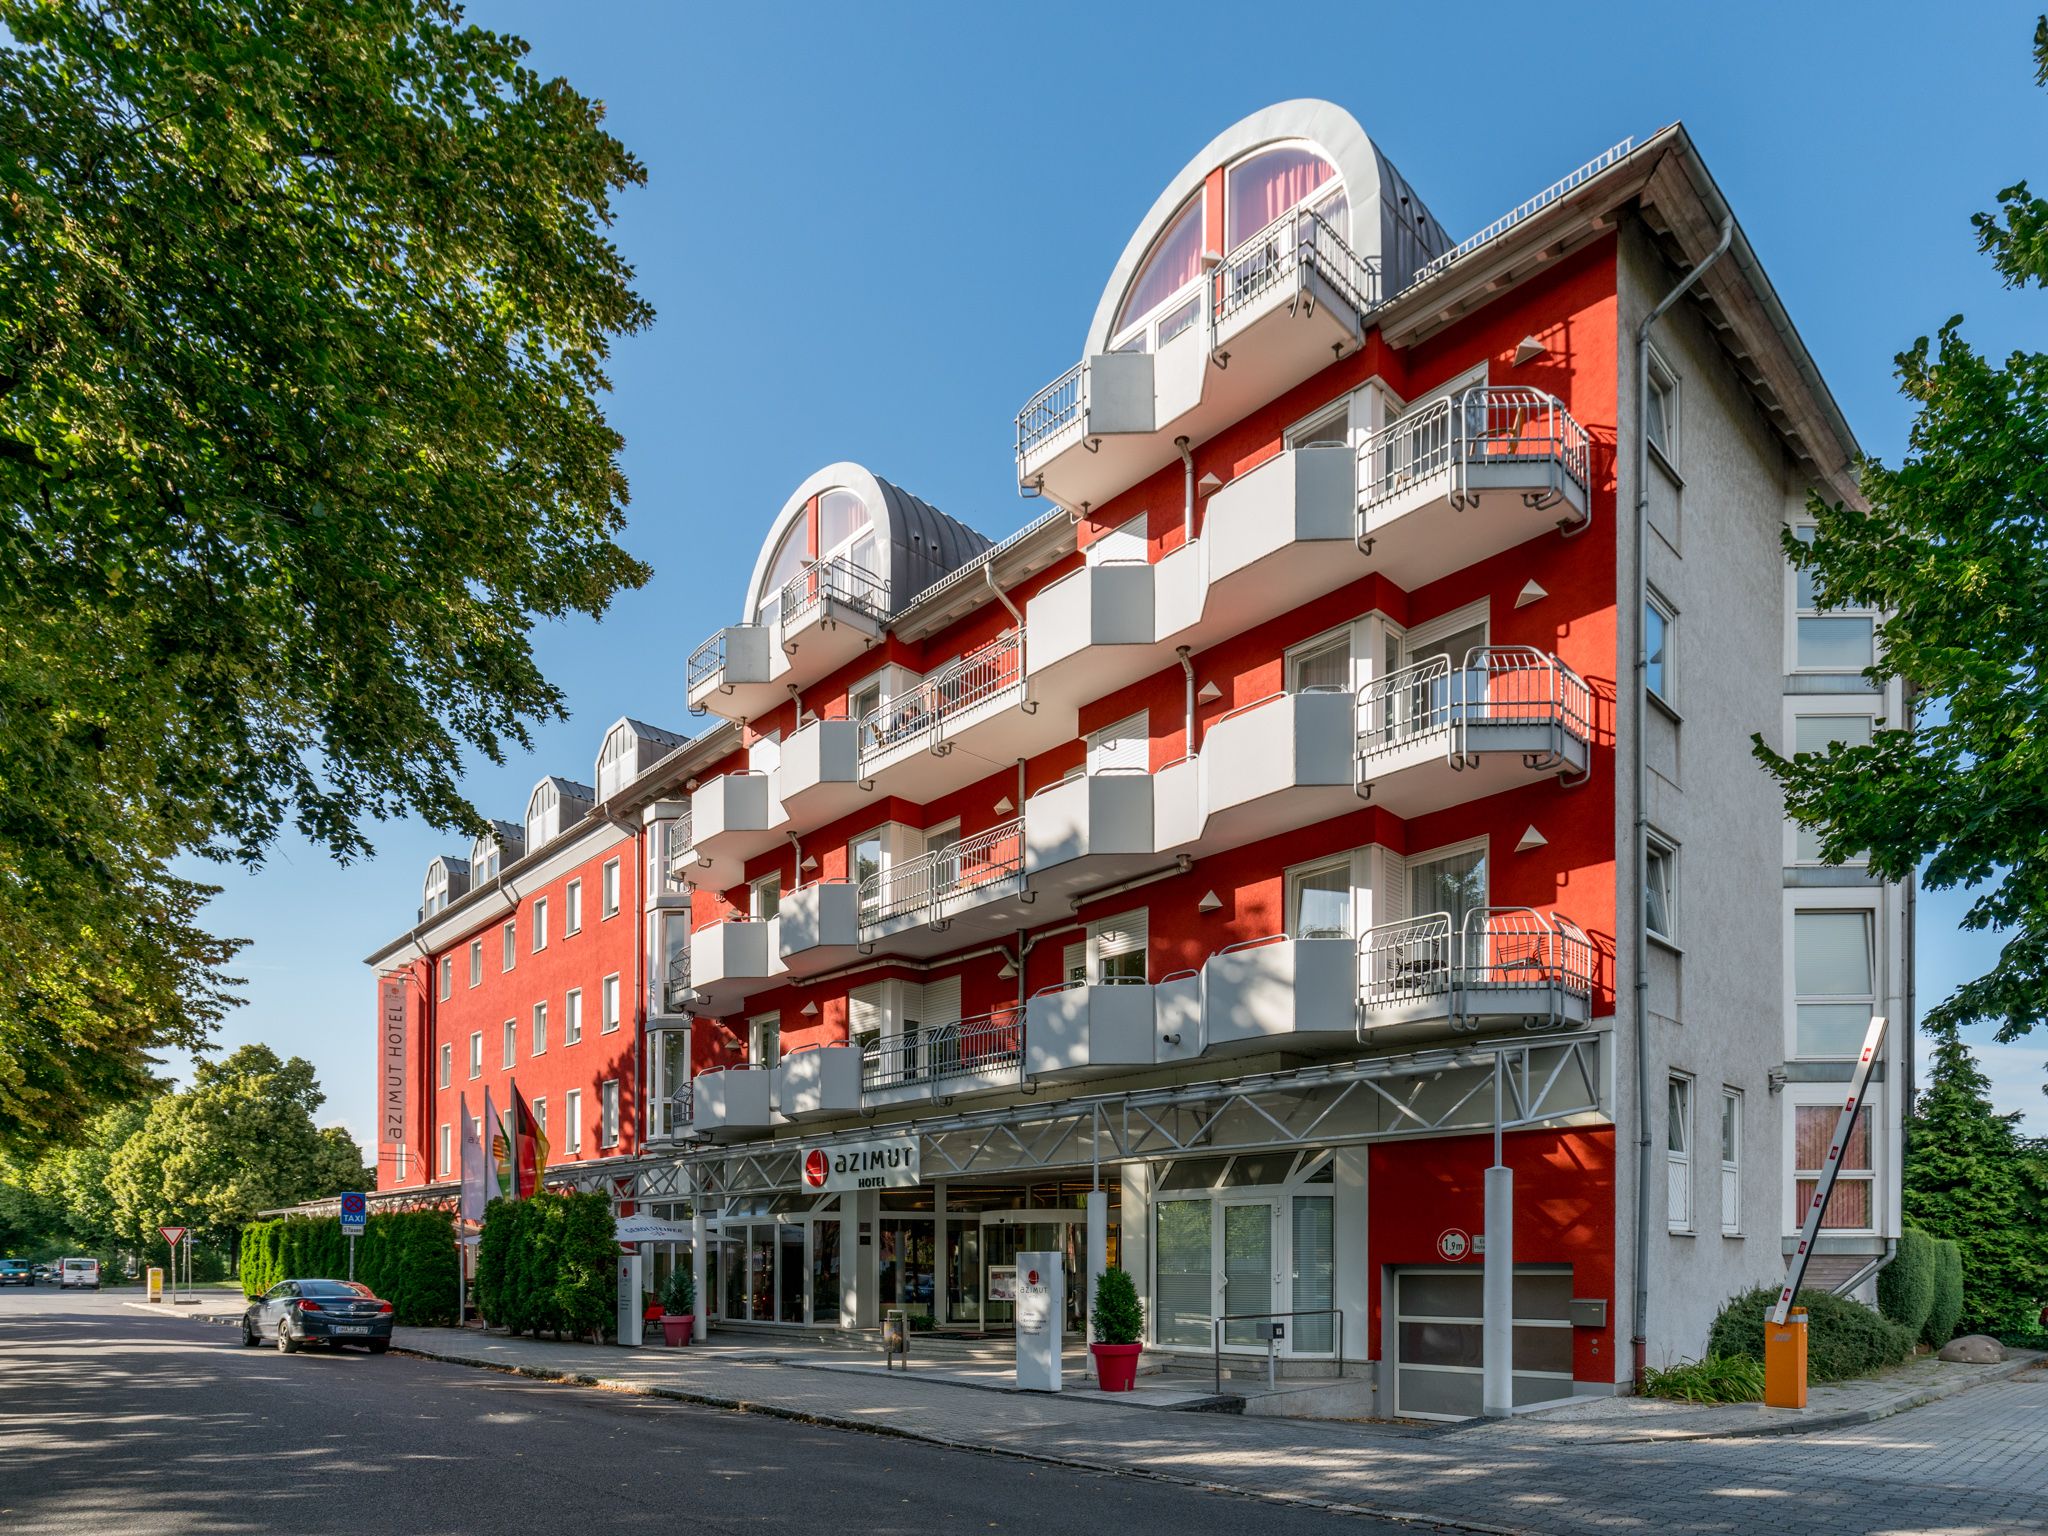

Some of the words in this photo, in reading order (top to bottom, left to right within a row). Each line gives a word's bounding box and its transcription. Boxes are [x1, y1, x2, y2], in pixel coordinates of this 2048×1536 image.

[388, 1006, 402, 1057] HOTEL
[858, 1176, 886, 1188] HOTEL
[343, 1214, 364, 1223] TAXI
[624, 1226, 683, 1234] GEROLSTEINER
